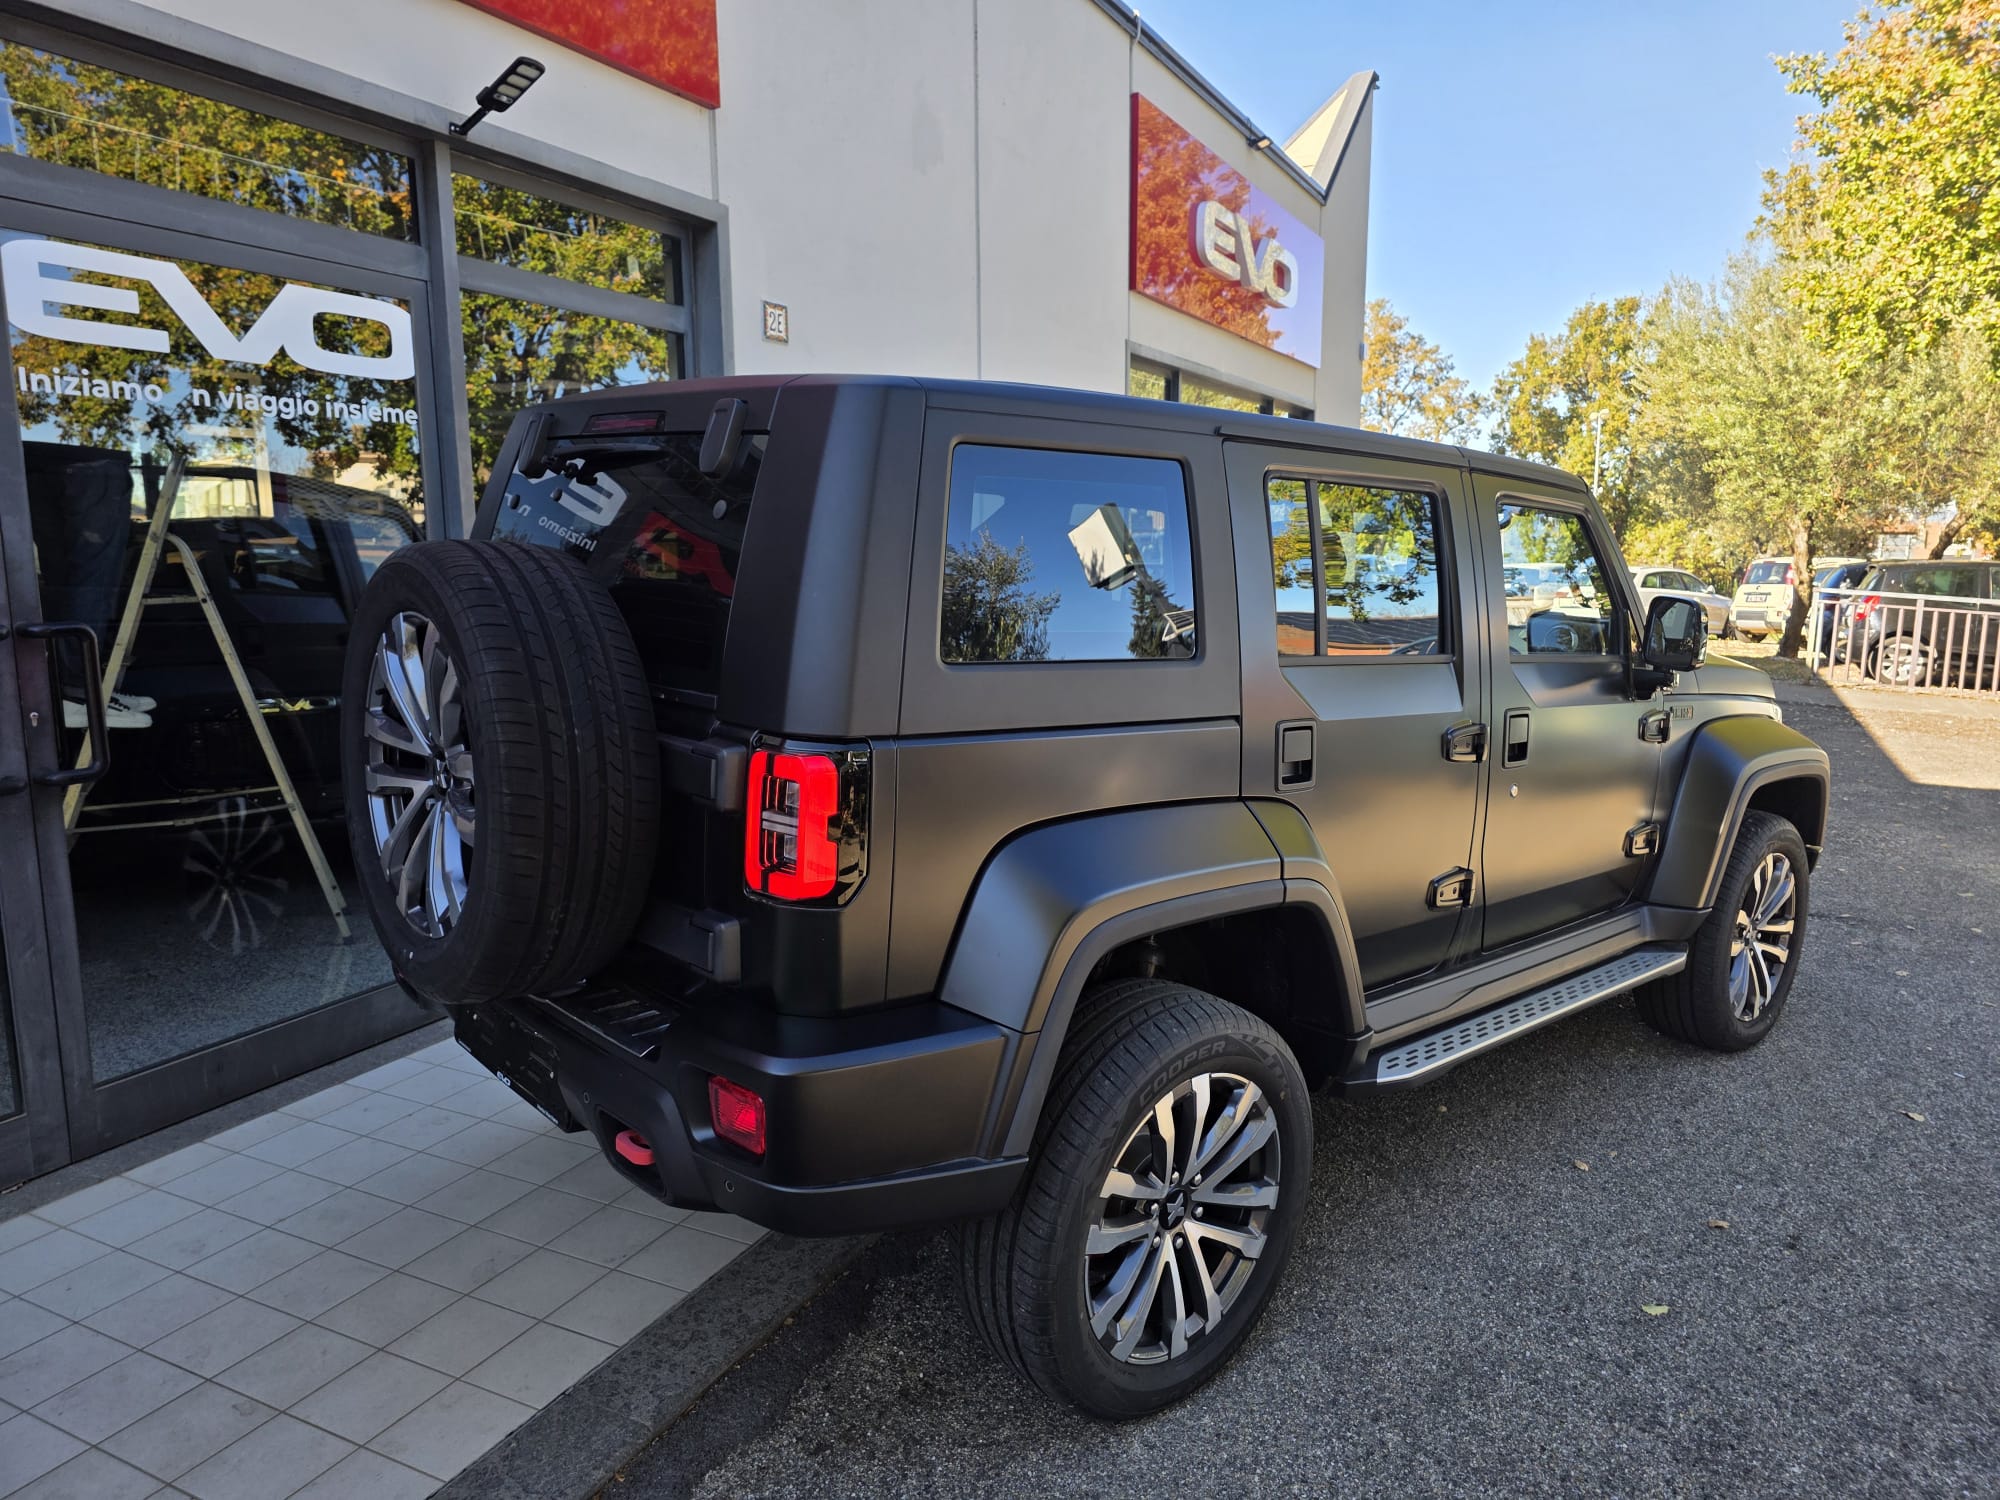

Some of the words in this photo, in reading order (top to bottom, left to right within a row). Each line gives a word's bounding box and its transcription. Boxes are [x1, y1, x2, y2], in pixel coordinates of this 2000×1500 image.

[1194, 200, 1298, 309] EVO
[1, 239, 415, 381] EVO
[769, 311, 783, 334] 2E
[18, 366, 163, 402] Iniziamo
[217, 385, 319, 420] viaggio
[325, 394, 418, 425] insieme
[1140, 1041, 1226, 1107] COOPER
